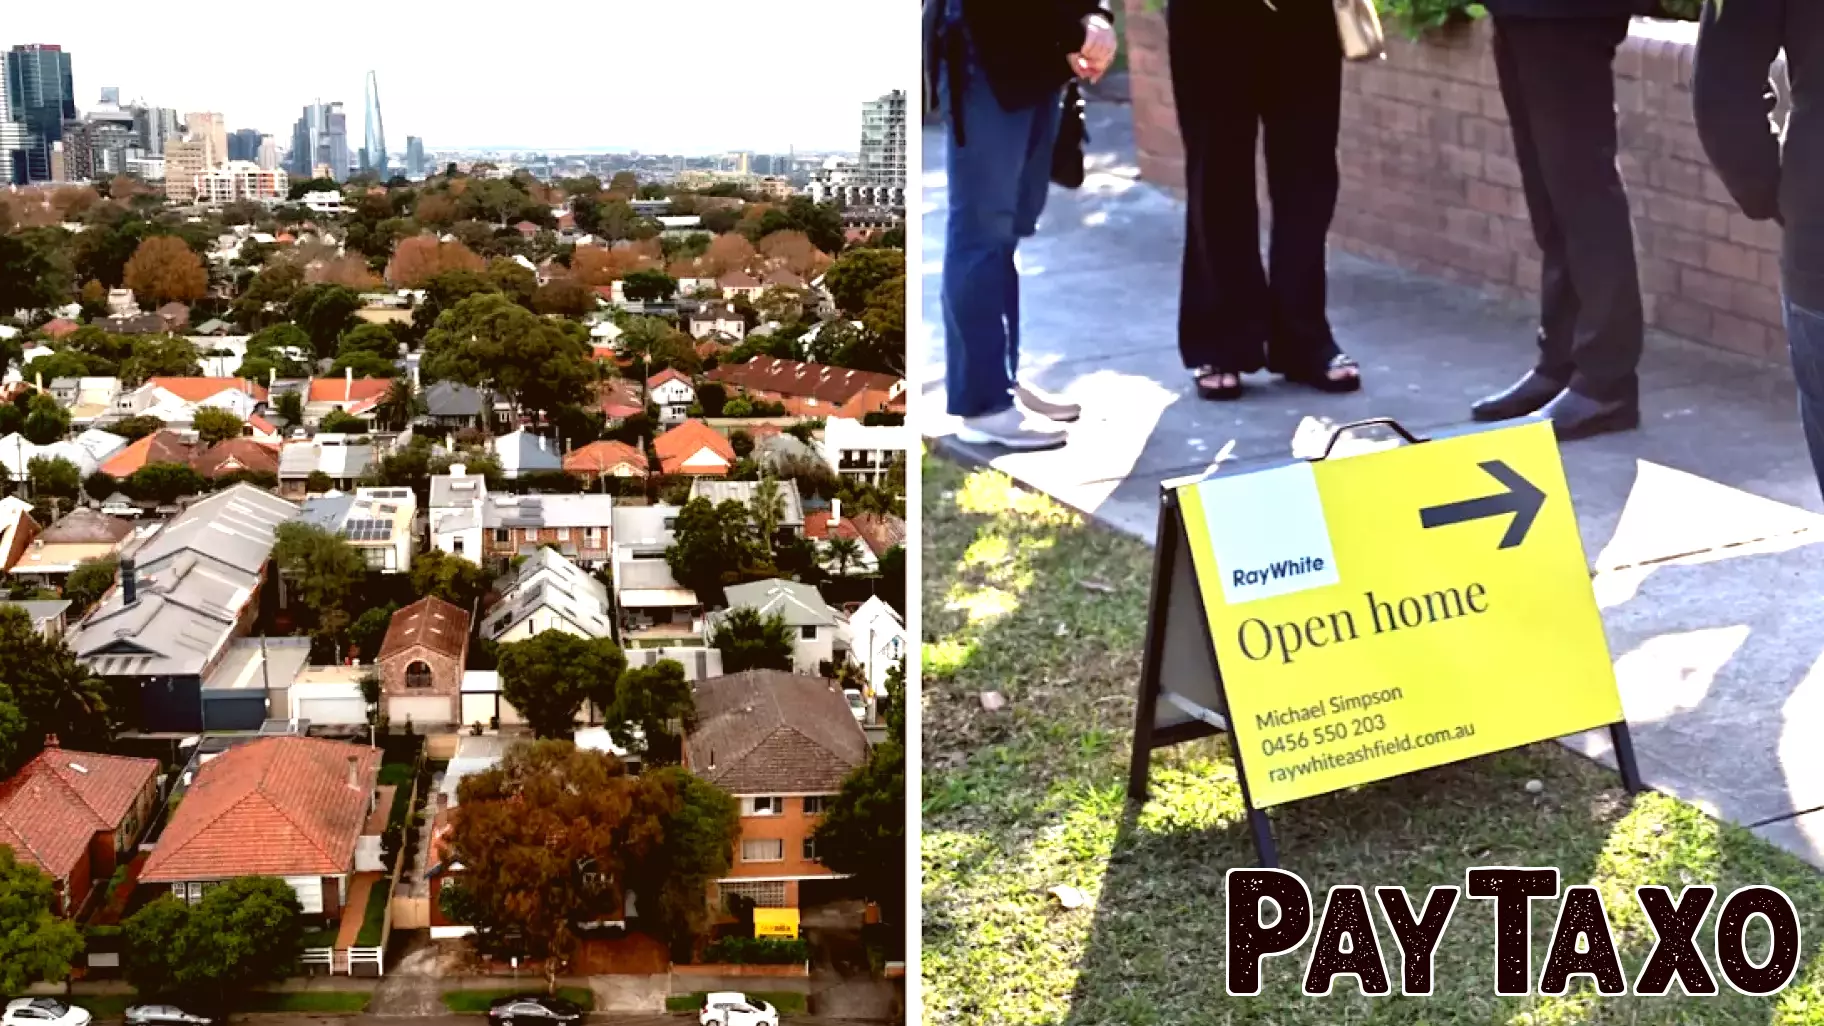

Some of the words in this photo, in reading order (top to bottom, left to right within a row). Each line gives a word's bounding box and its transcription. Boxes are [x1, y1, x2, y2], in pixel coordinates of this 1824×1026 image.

[1232, 556, 1324, 588] RayWhite
[1237, 609, 1360, 665] Open
[1363, 581, 1490, 635] home
[1255, 700, 1326, 731] Michael
[1329, 686, 1404, 715] Simpson
[1261, 731, 1310, 757] 0456
[1313, 722, 1348, 745] 550
[1351, 714, 1387, 737] 203
[1268, 722, 1476, 783] raywhiteashfield.com.au
